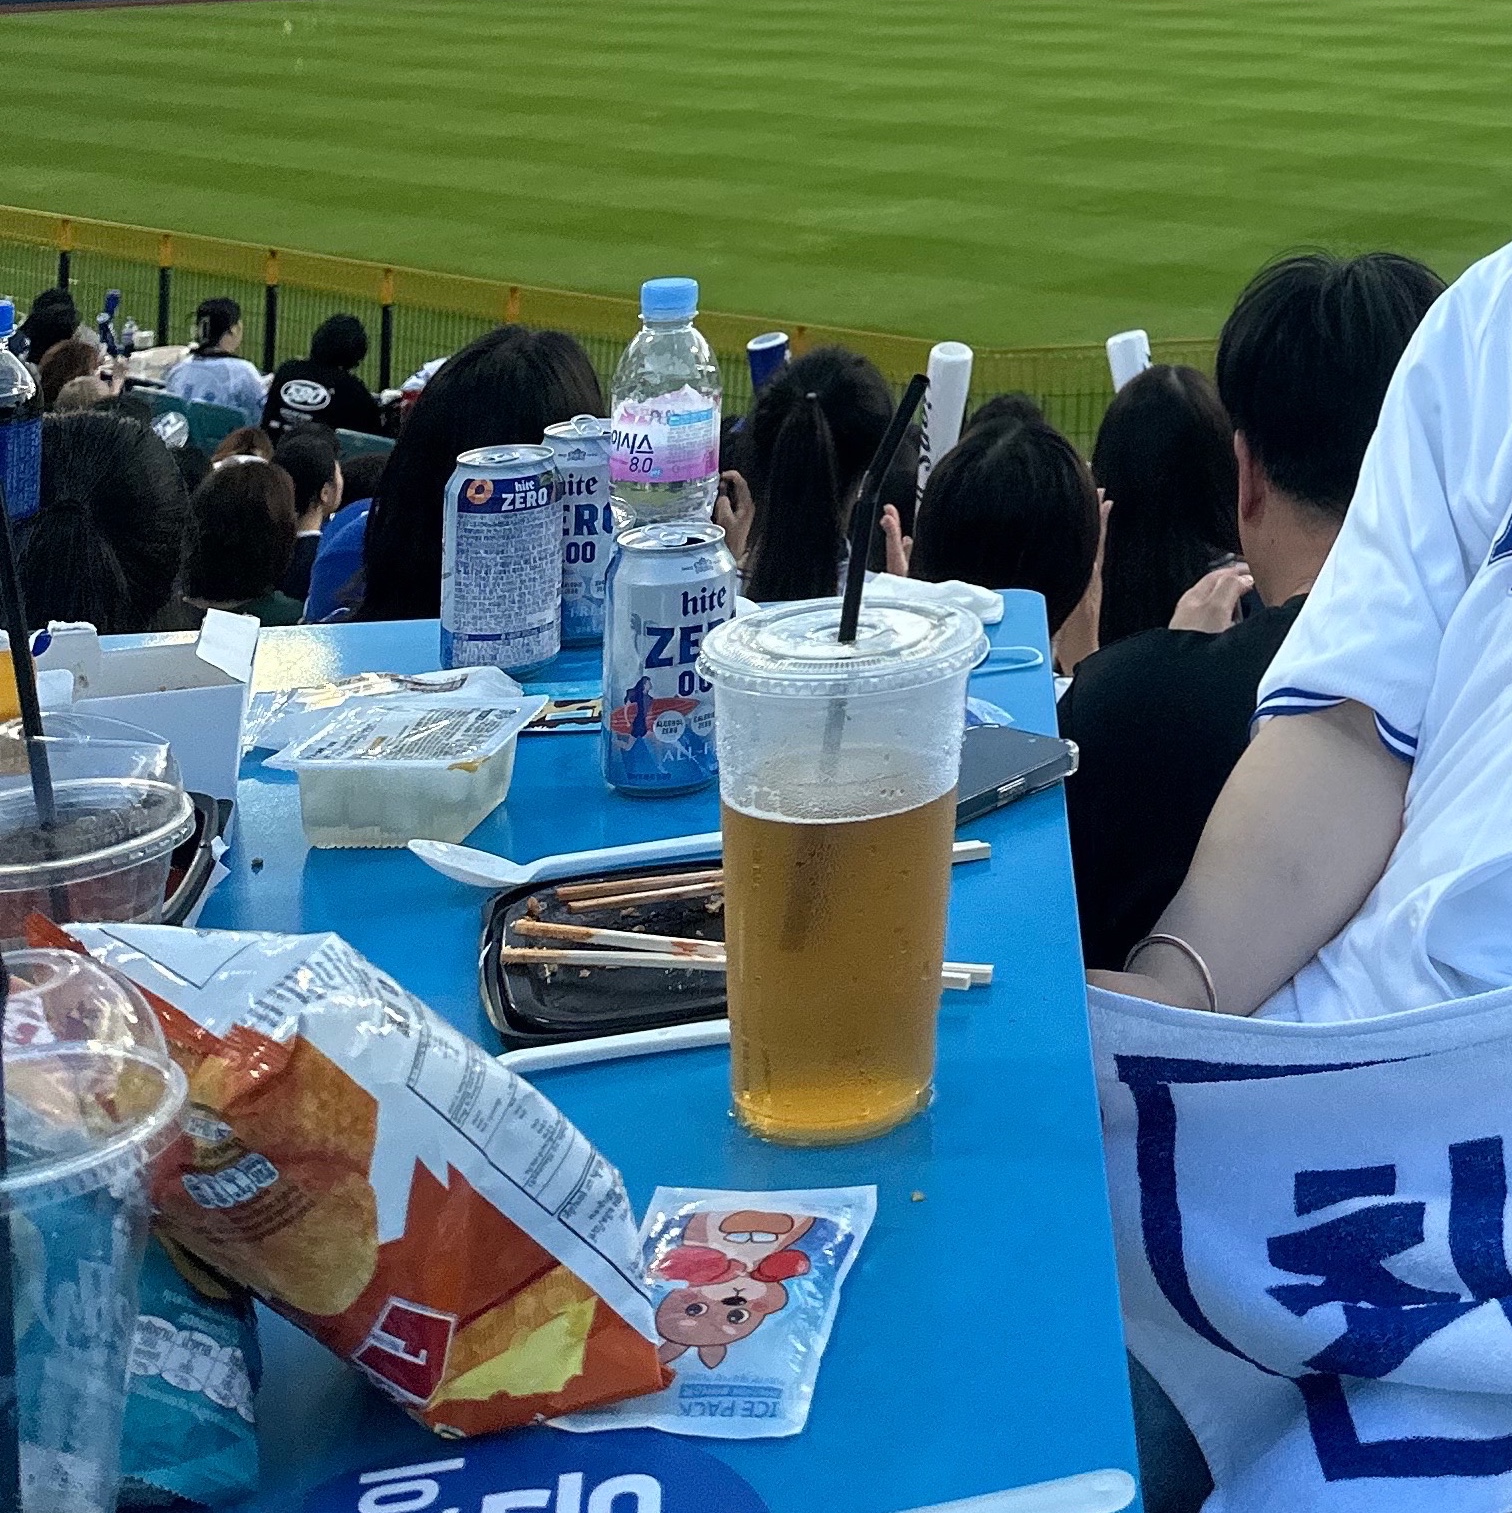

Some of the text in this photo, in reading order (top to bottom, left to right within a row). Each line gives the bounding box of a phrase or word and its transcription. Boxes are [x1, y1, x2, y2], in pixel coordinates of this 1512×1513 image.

[611, 429, 654, 455] 이시스
[629, 456, 653, 474] 8.0
[515, 479, 535, 492] hite
[502, 488, 548, 512] ZERO
[682, 585, 726, 617] hite
[645, 618, 726, 670] ZE
[739, 1400, 781, 1419] ICE
